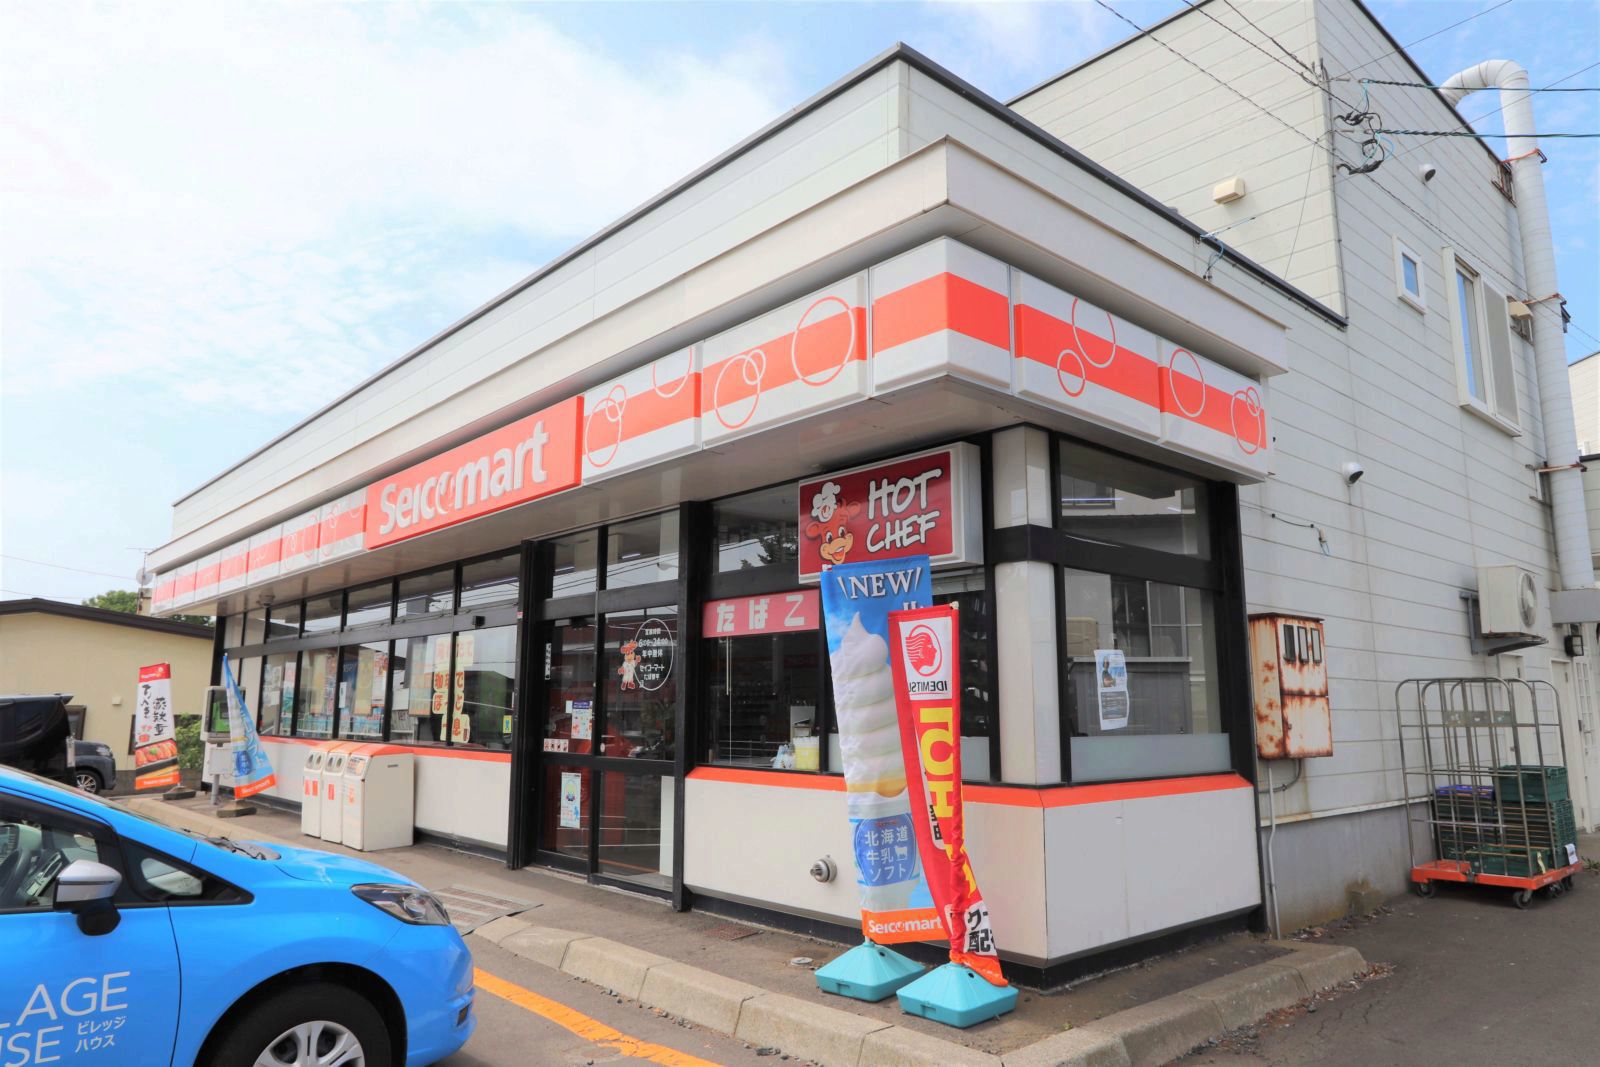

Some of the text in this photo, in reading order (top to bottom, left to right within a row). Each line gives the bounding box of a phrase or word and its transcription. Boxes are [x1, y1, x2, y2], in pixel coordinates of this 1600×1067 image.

[868, 468, 943, 520] HOT
[866, 510, 940, 553] CHEF
[848, 569, 914, 600] NEW
[716, 594, 805, 633] たばこ
[864, 825, 909, 847] 北海道
[866, 848, 894, 866] 牛乳
[870, 863, 906, 882] ソフト
[0, 971, 131, 1030] AGE
[77, 1016, 127, 1036] ビレッジ
[0, 1026, 64, 1067] SE
[75, 1034, 116, 1053] ハウス
